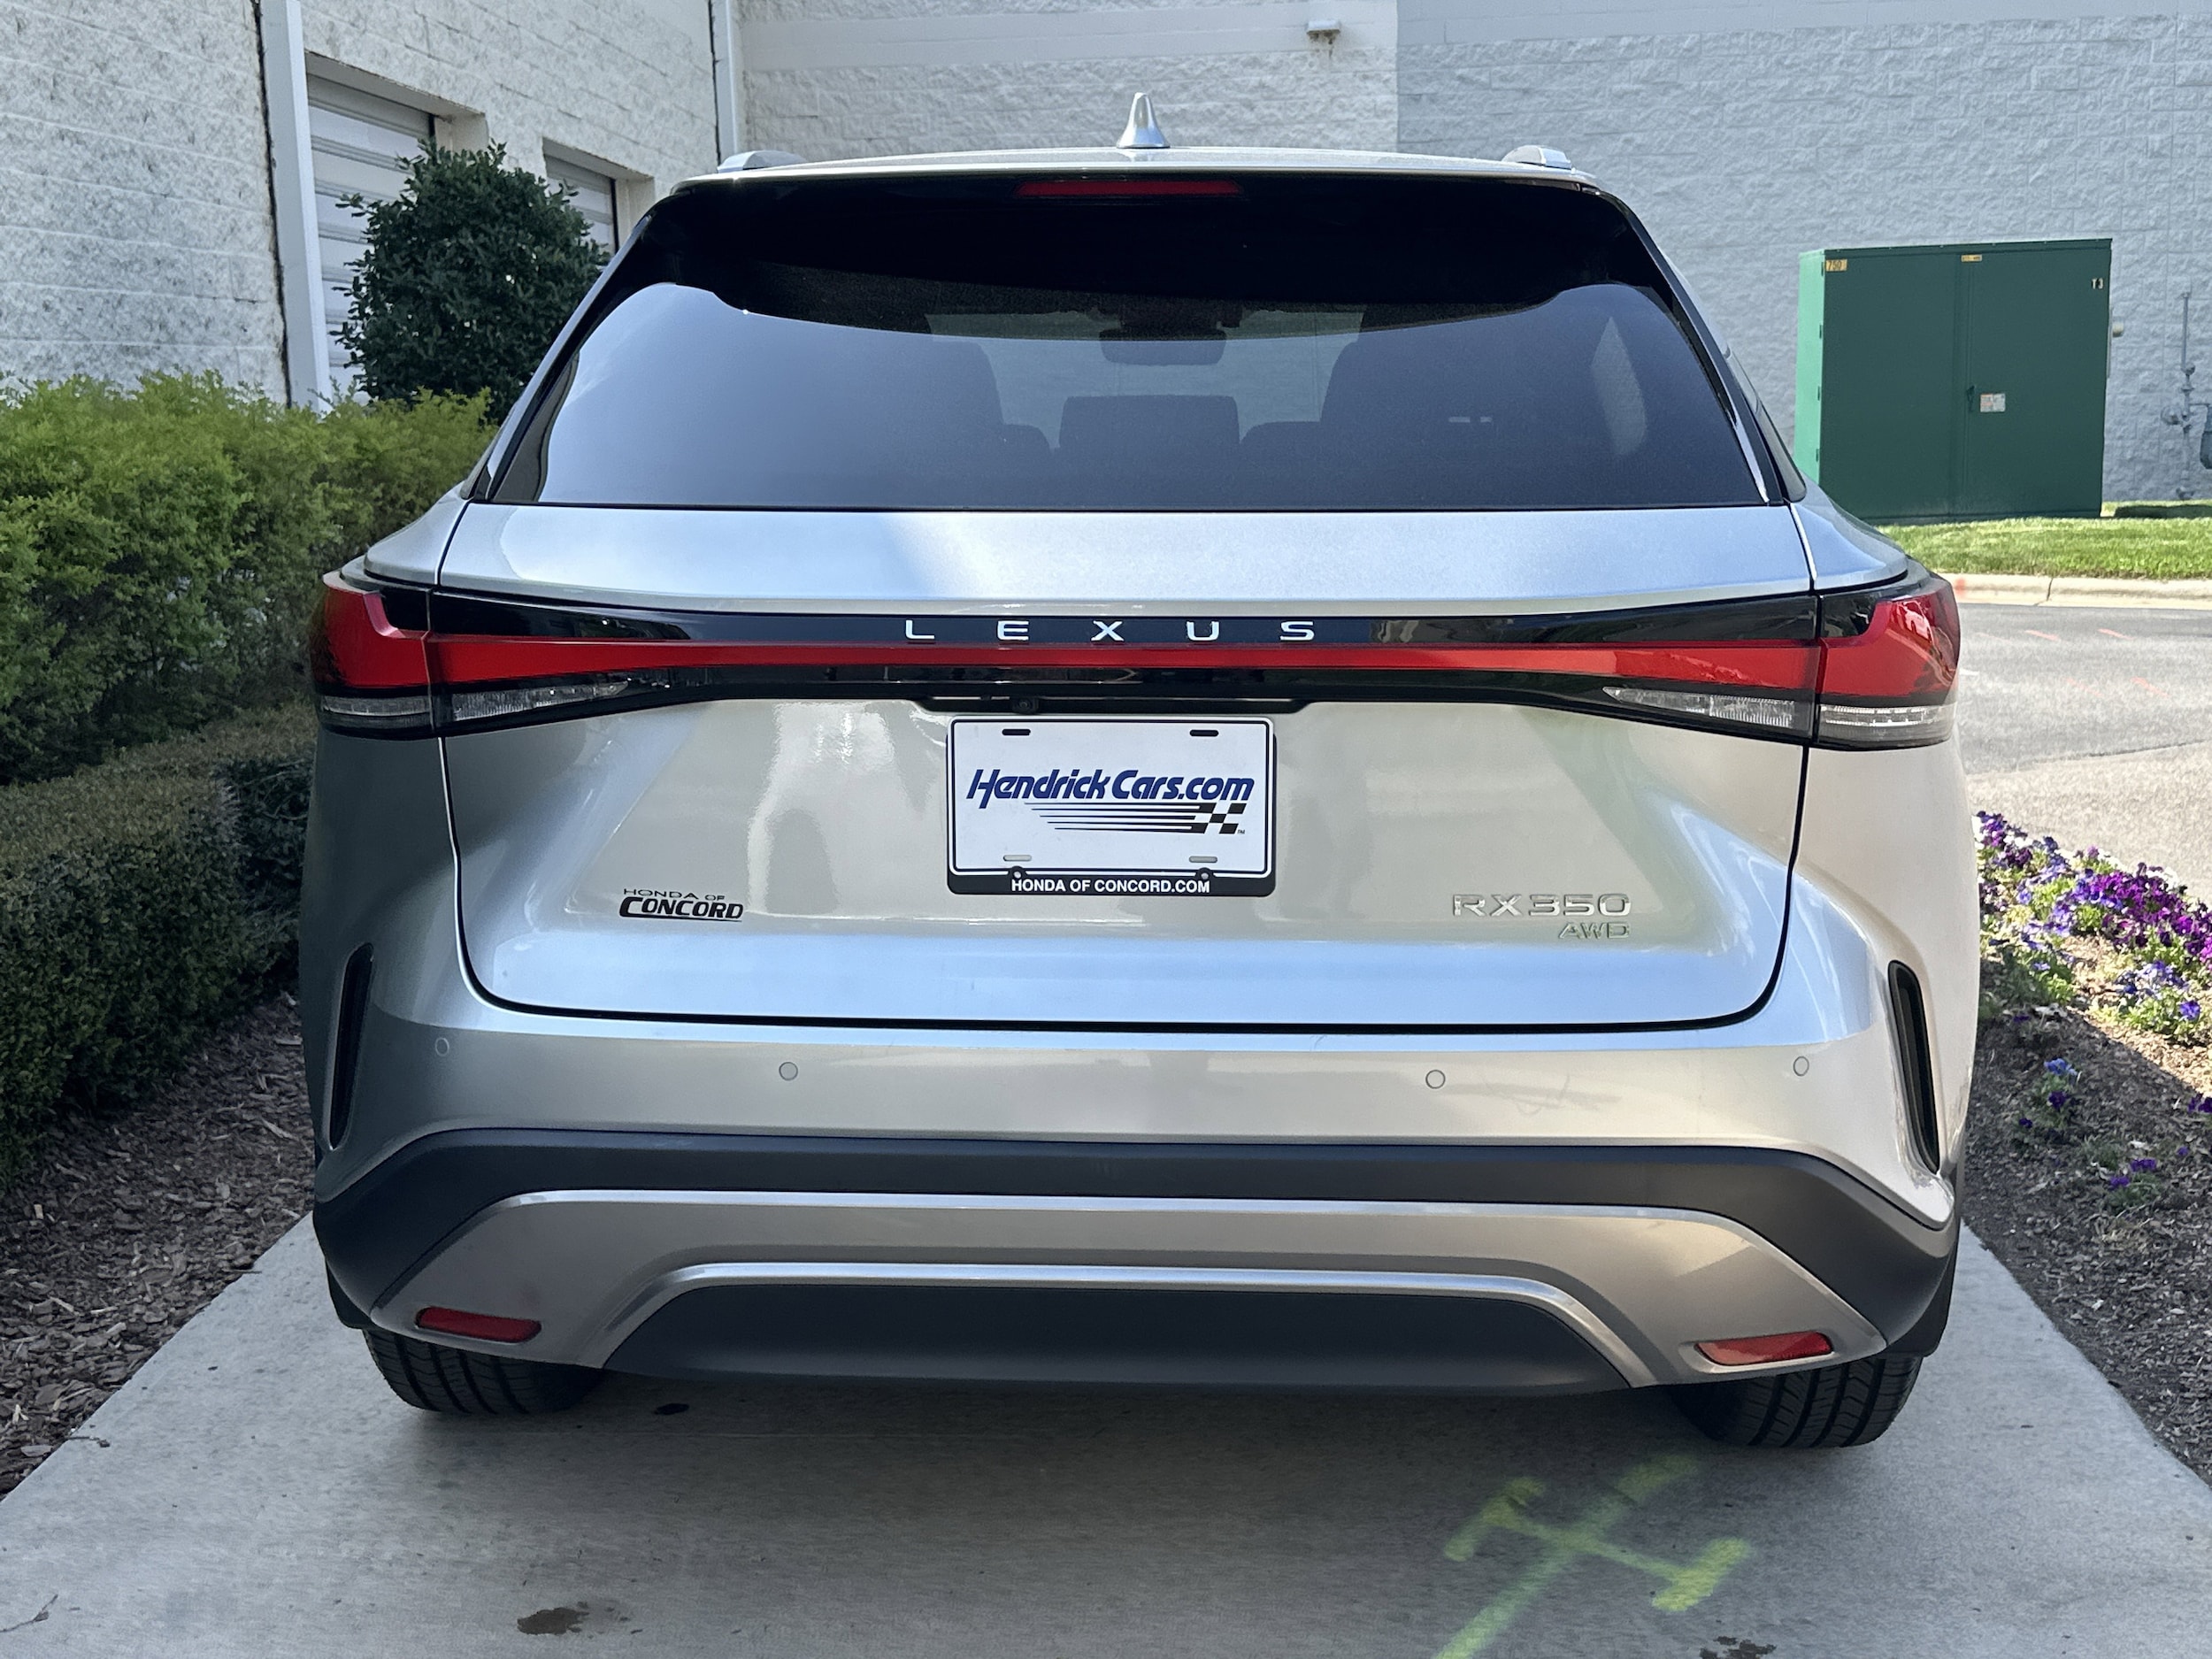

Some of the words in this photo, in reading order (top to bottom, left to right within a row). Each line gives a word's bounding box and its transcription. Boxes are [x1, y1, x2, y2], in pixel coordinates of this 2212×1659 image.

[905, 619, 1316, 641] LEXUS
[623, 888, 699, 900] HONDA
[1011, 879, 1066, 892] HONDA
[1069, 879, 1091, 892] OF
[1094, 879, 1210, 894] CONCORD.COM
[619, 896, 744, 922] CONCORD
[1557, 921, 1630, 940] AWD
